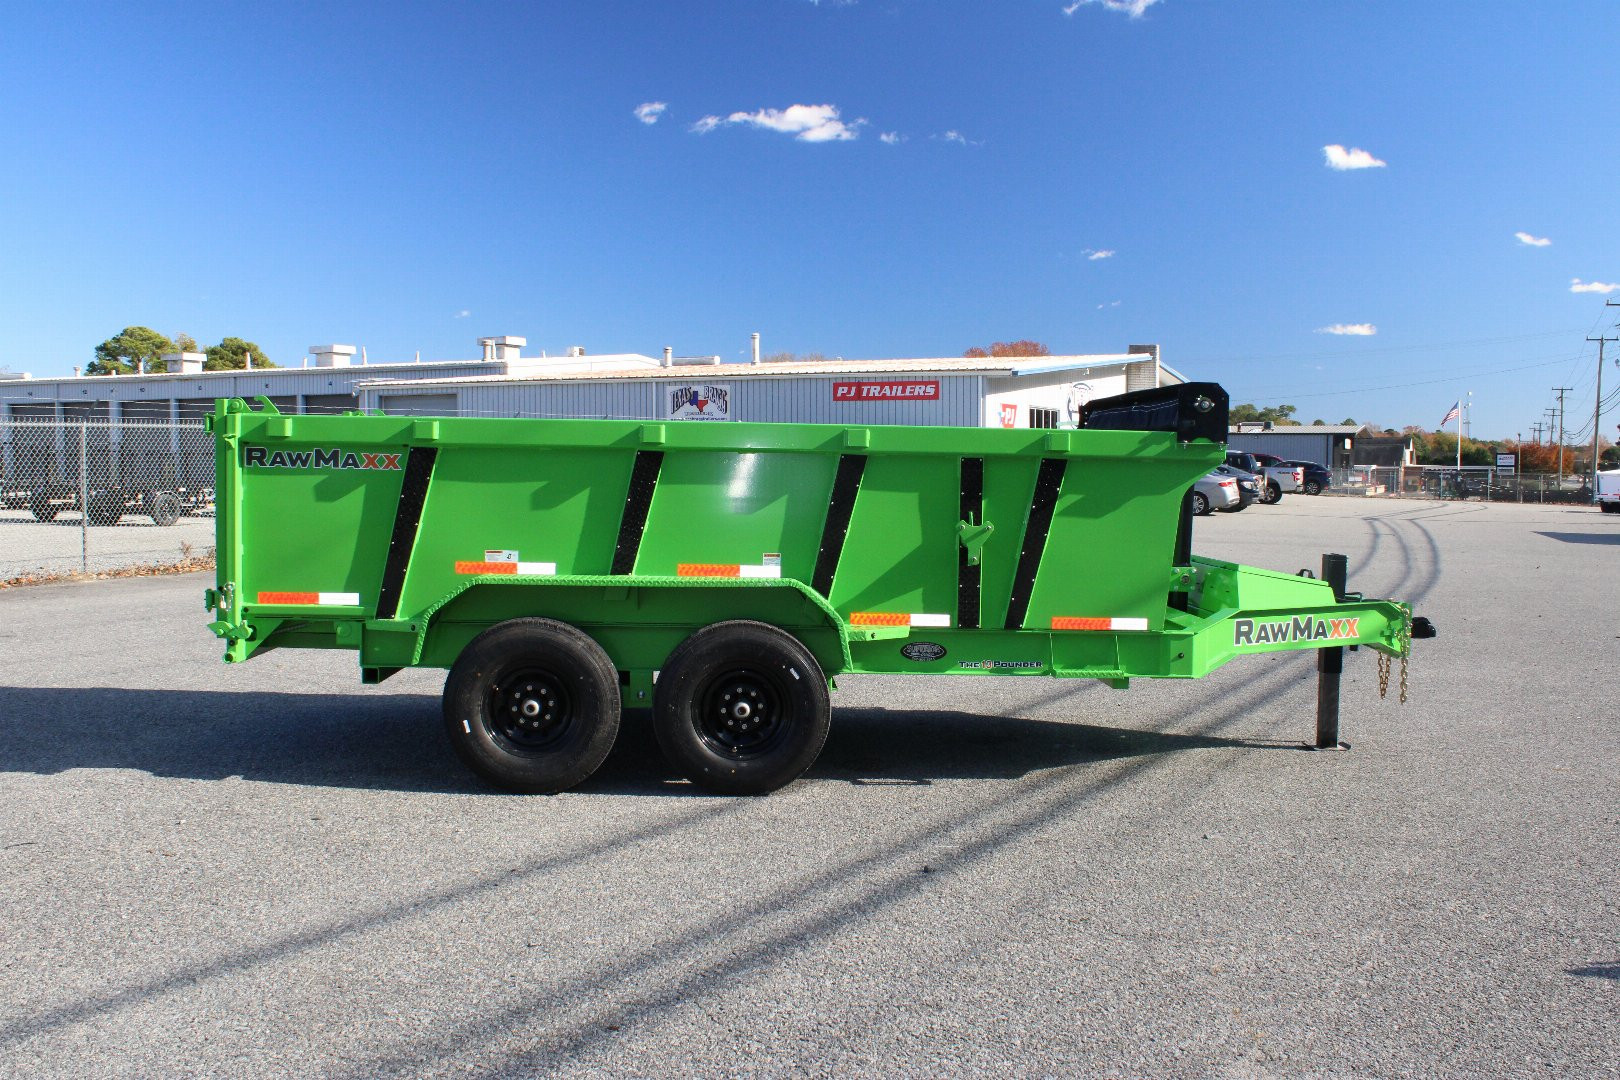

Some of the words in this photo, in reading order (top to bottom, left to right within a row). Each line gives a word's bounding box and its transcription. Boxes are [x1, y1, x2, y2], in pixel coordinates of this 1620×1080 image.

[837, 386, 857, 397] PJ
[861, 385, 936, 397] TRAILERS
[670, 387, 692, 414] TEXAS
[704, 386, 727, 414] BRAGG
[1004, 407, 1016, 425] PJ
[981, 659, 993, 669] 13
[993, 661, 1043, 669] POUNDER
